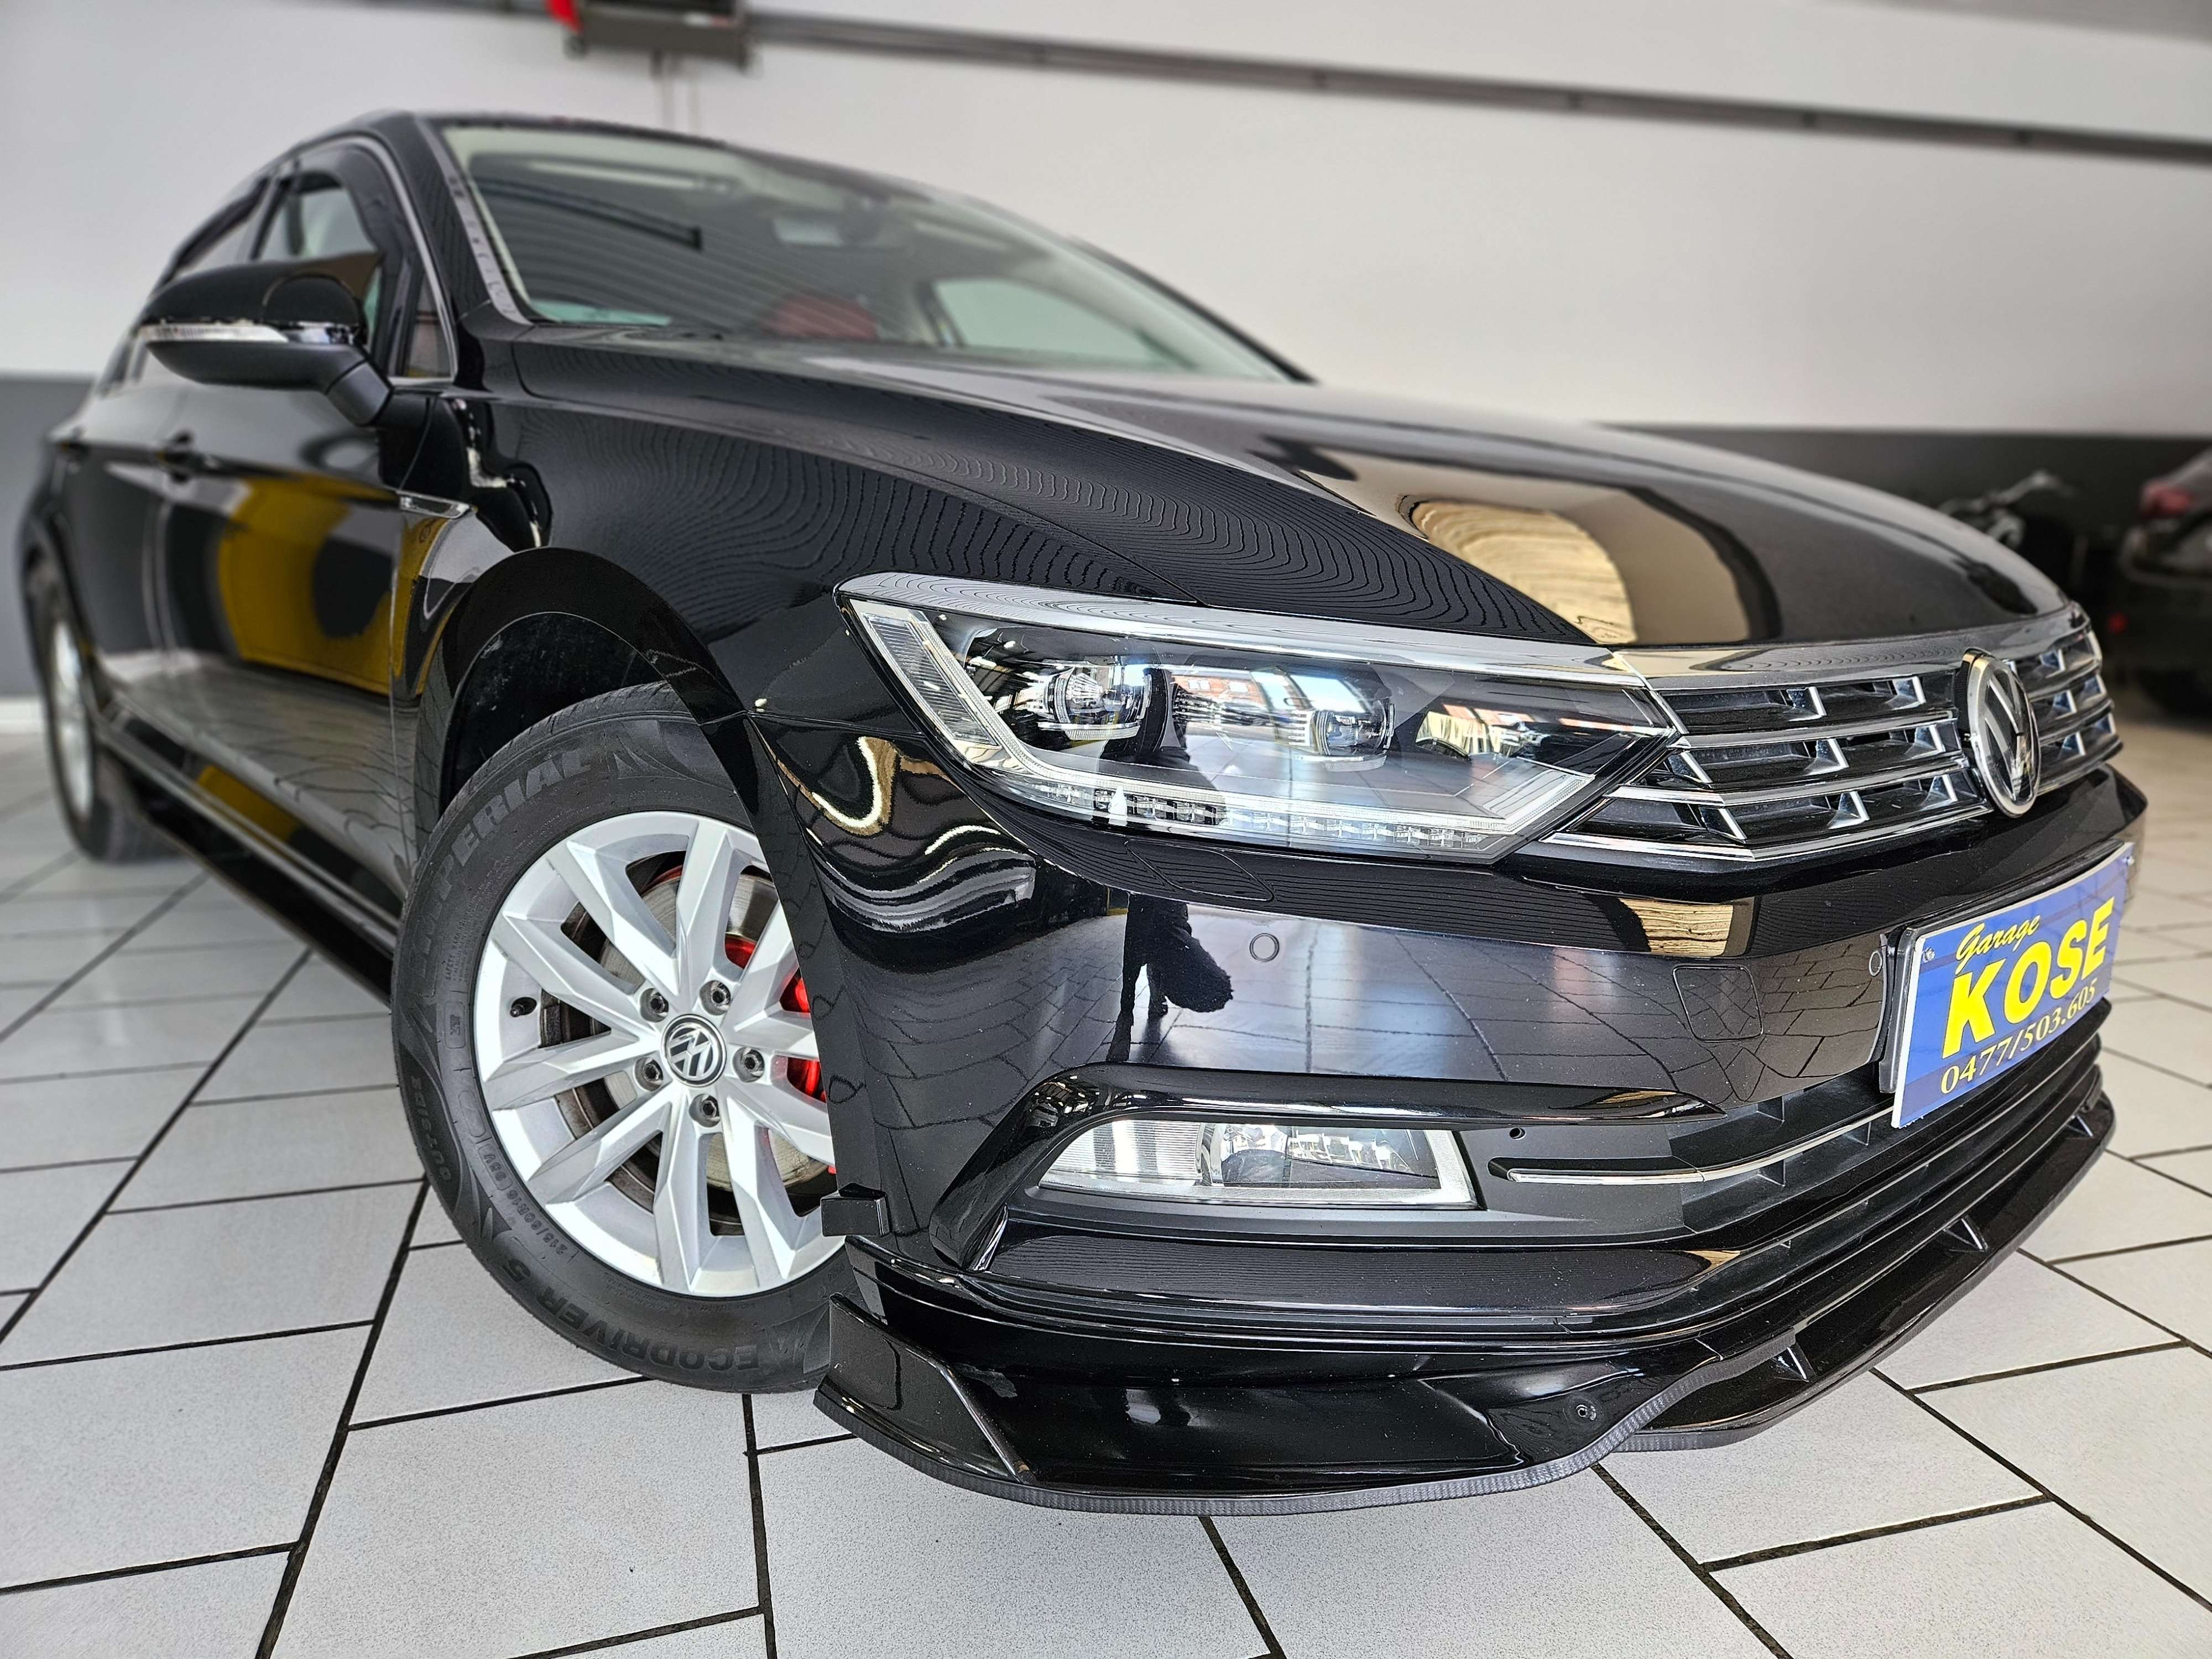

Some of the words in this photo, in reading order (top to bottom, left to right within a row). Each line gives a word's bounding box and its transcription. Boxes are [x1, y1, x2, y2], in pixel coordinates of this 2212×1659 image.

[1942, 896, 2115, 1059] KOSE
[1955, 915, 2040, 974] Garage
[1940, 981, 2096, 1094] 0477/503.605
[507, 1190, 568, 1255] 215/60R16
[499, 1258, 531, 1284] 5
[535, 1285, 760, 1371] ECODRIVER
